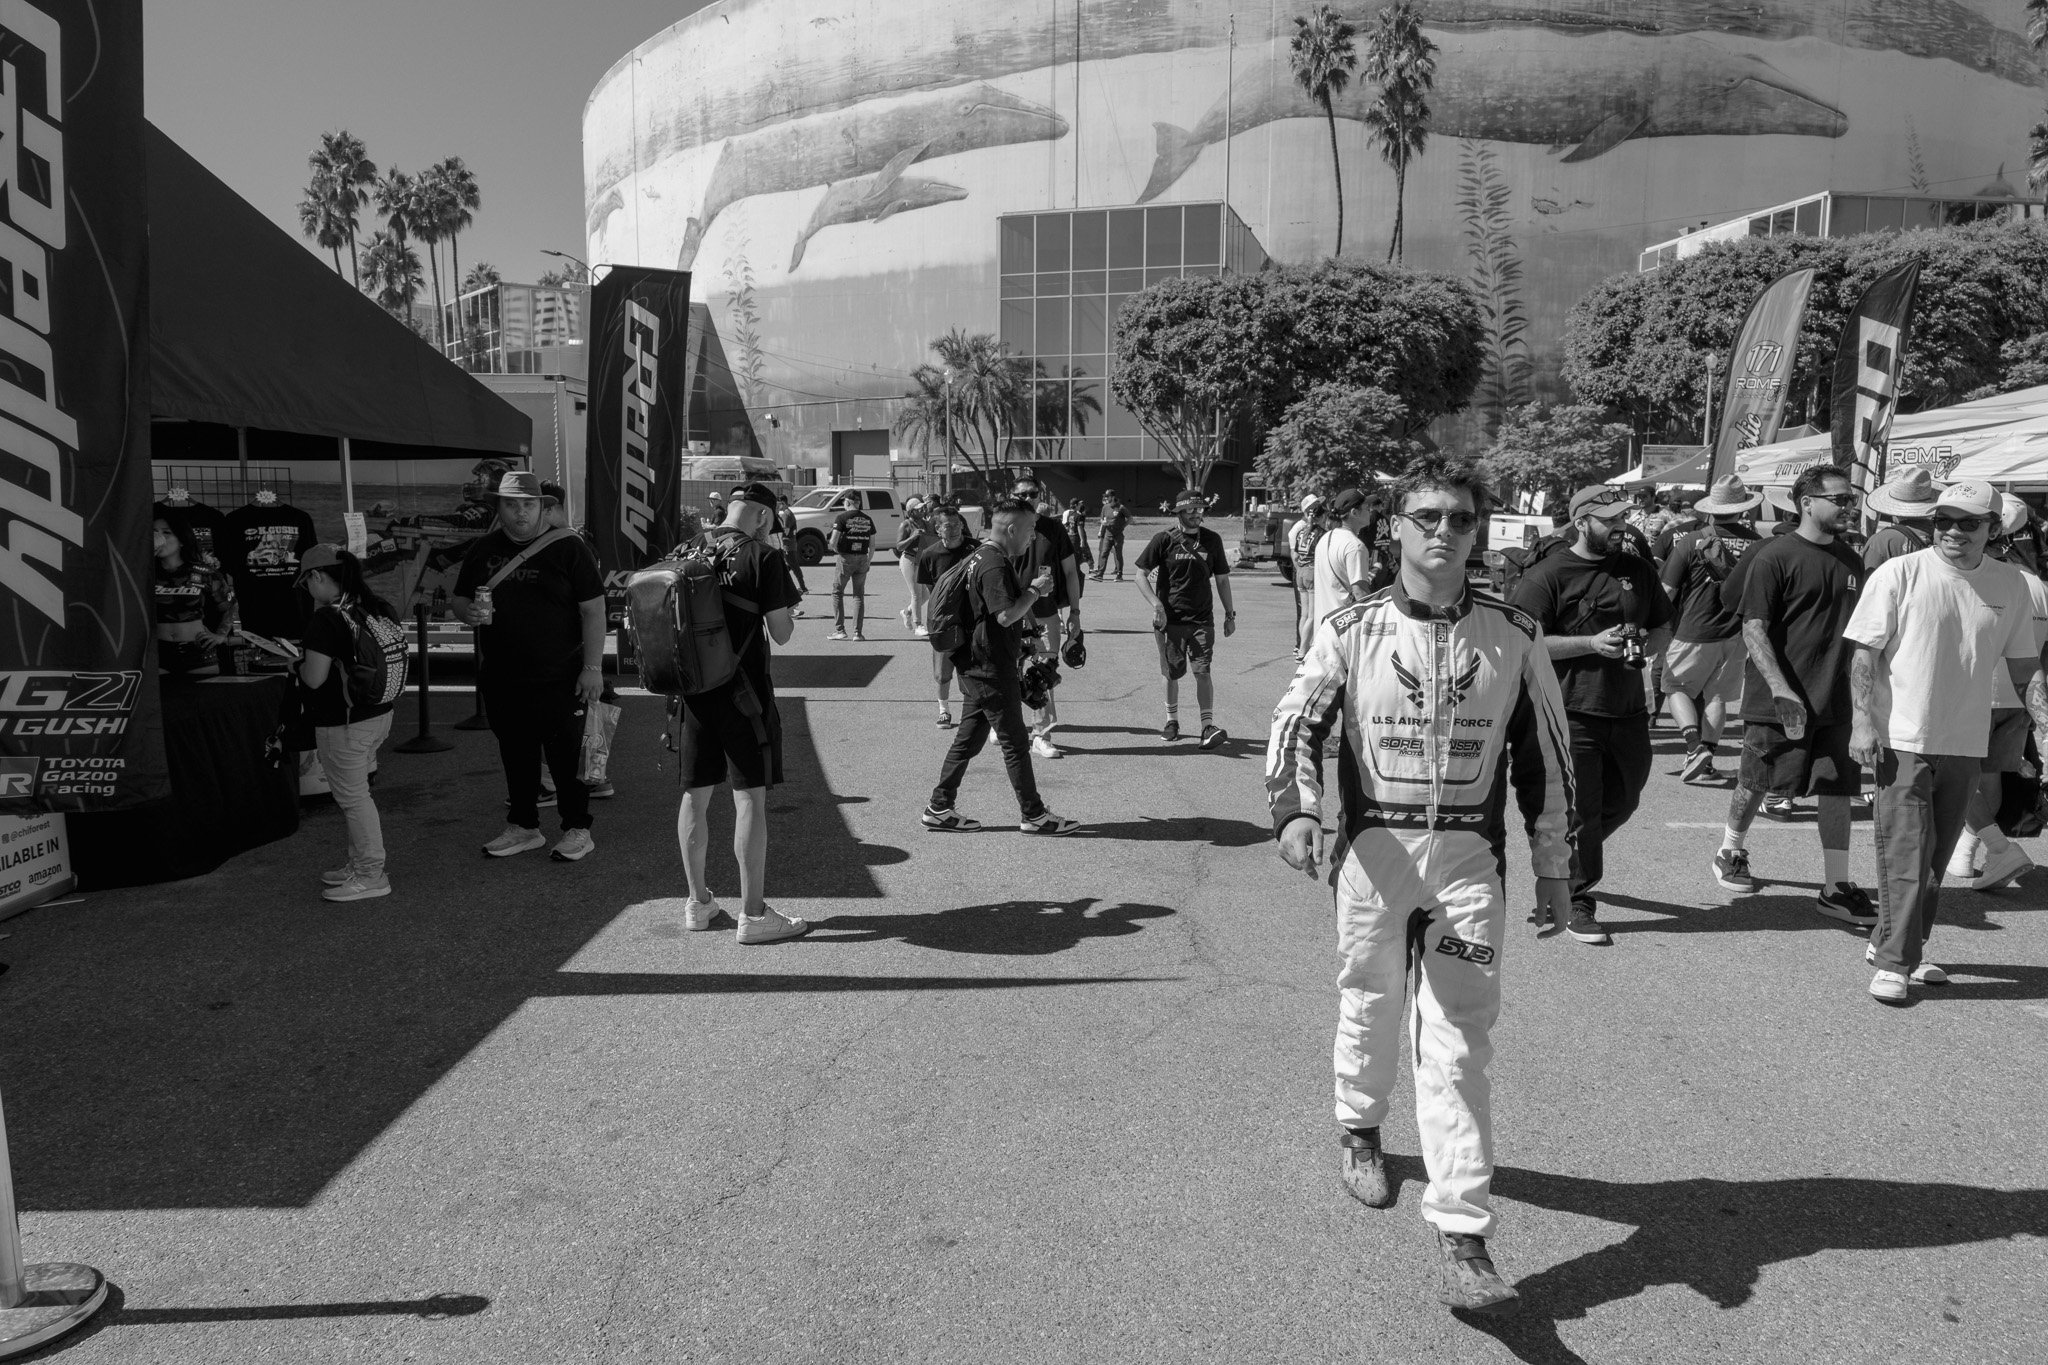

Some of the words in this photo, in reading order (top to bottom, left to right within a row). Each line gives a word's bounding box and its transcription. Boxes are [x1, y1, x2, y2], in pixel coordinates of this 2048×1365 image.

[1747, 345, 1783, 373] 171
[1735, 378, 1781, 390] ROME
[622, 299, 660, 555] GReddy
[1890, 446, 1952, 465] ROME
[154, 585, 201, 595] Reddy
[13, 717, 128, 735] GUSHI
[1373, 716, 1396, 724] U.S.
[1398, 717, 1421, 726] AIR
[1453, 718, 1494, 727] FORCE
[44, 757, 126, 769] TOYOTA
[0, 773, 32, 796] R
[41, 770, 118, 782] GAZOO
[40, 783, 116, 797] Racing
[0, 843, 44, 873] ILABLE
[46, 837, 59, 854] IN
[28, 864, 62, 884] amazon
[0, 880, 21, 896] STCO
[1437, 936, 1494, 965] 513
